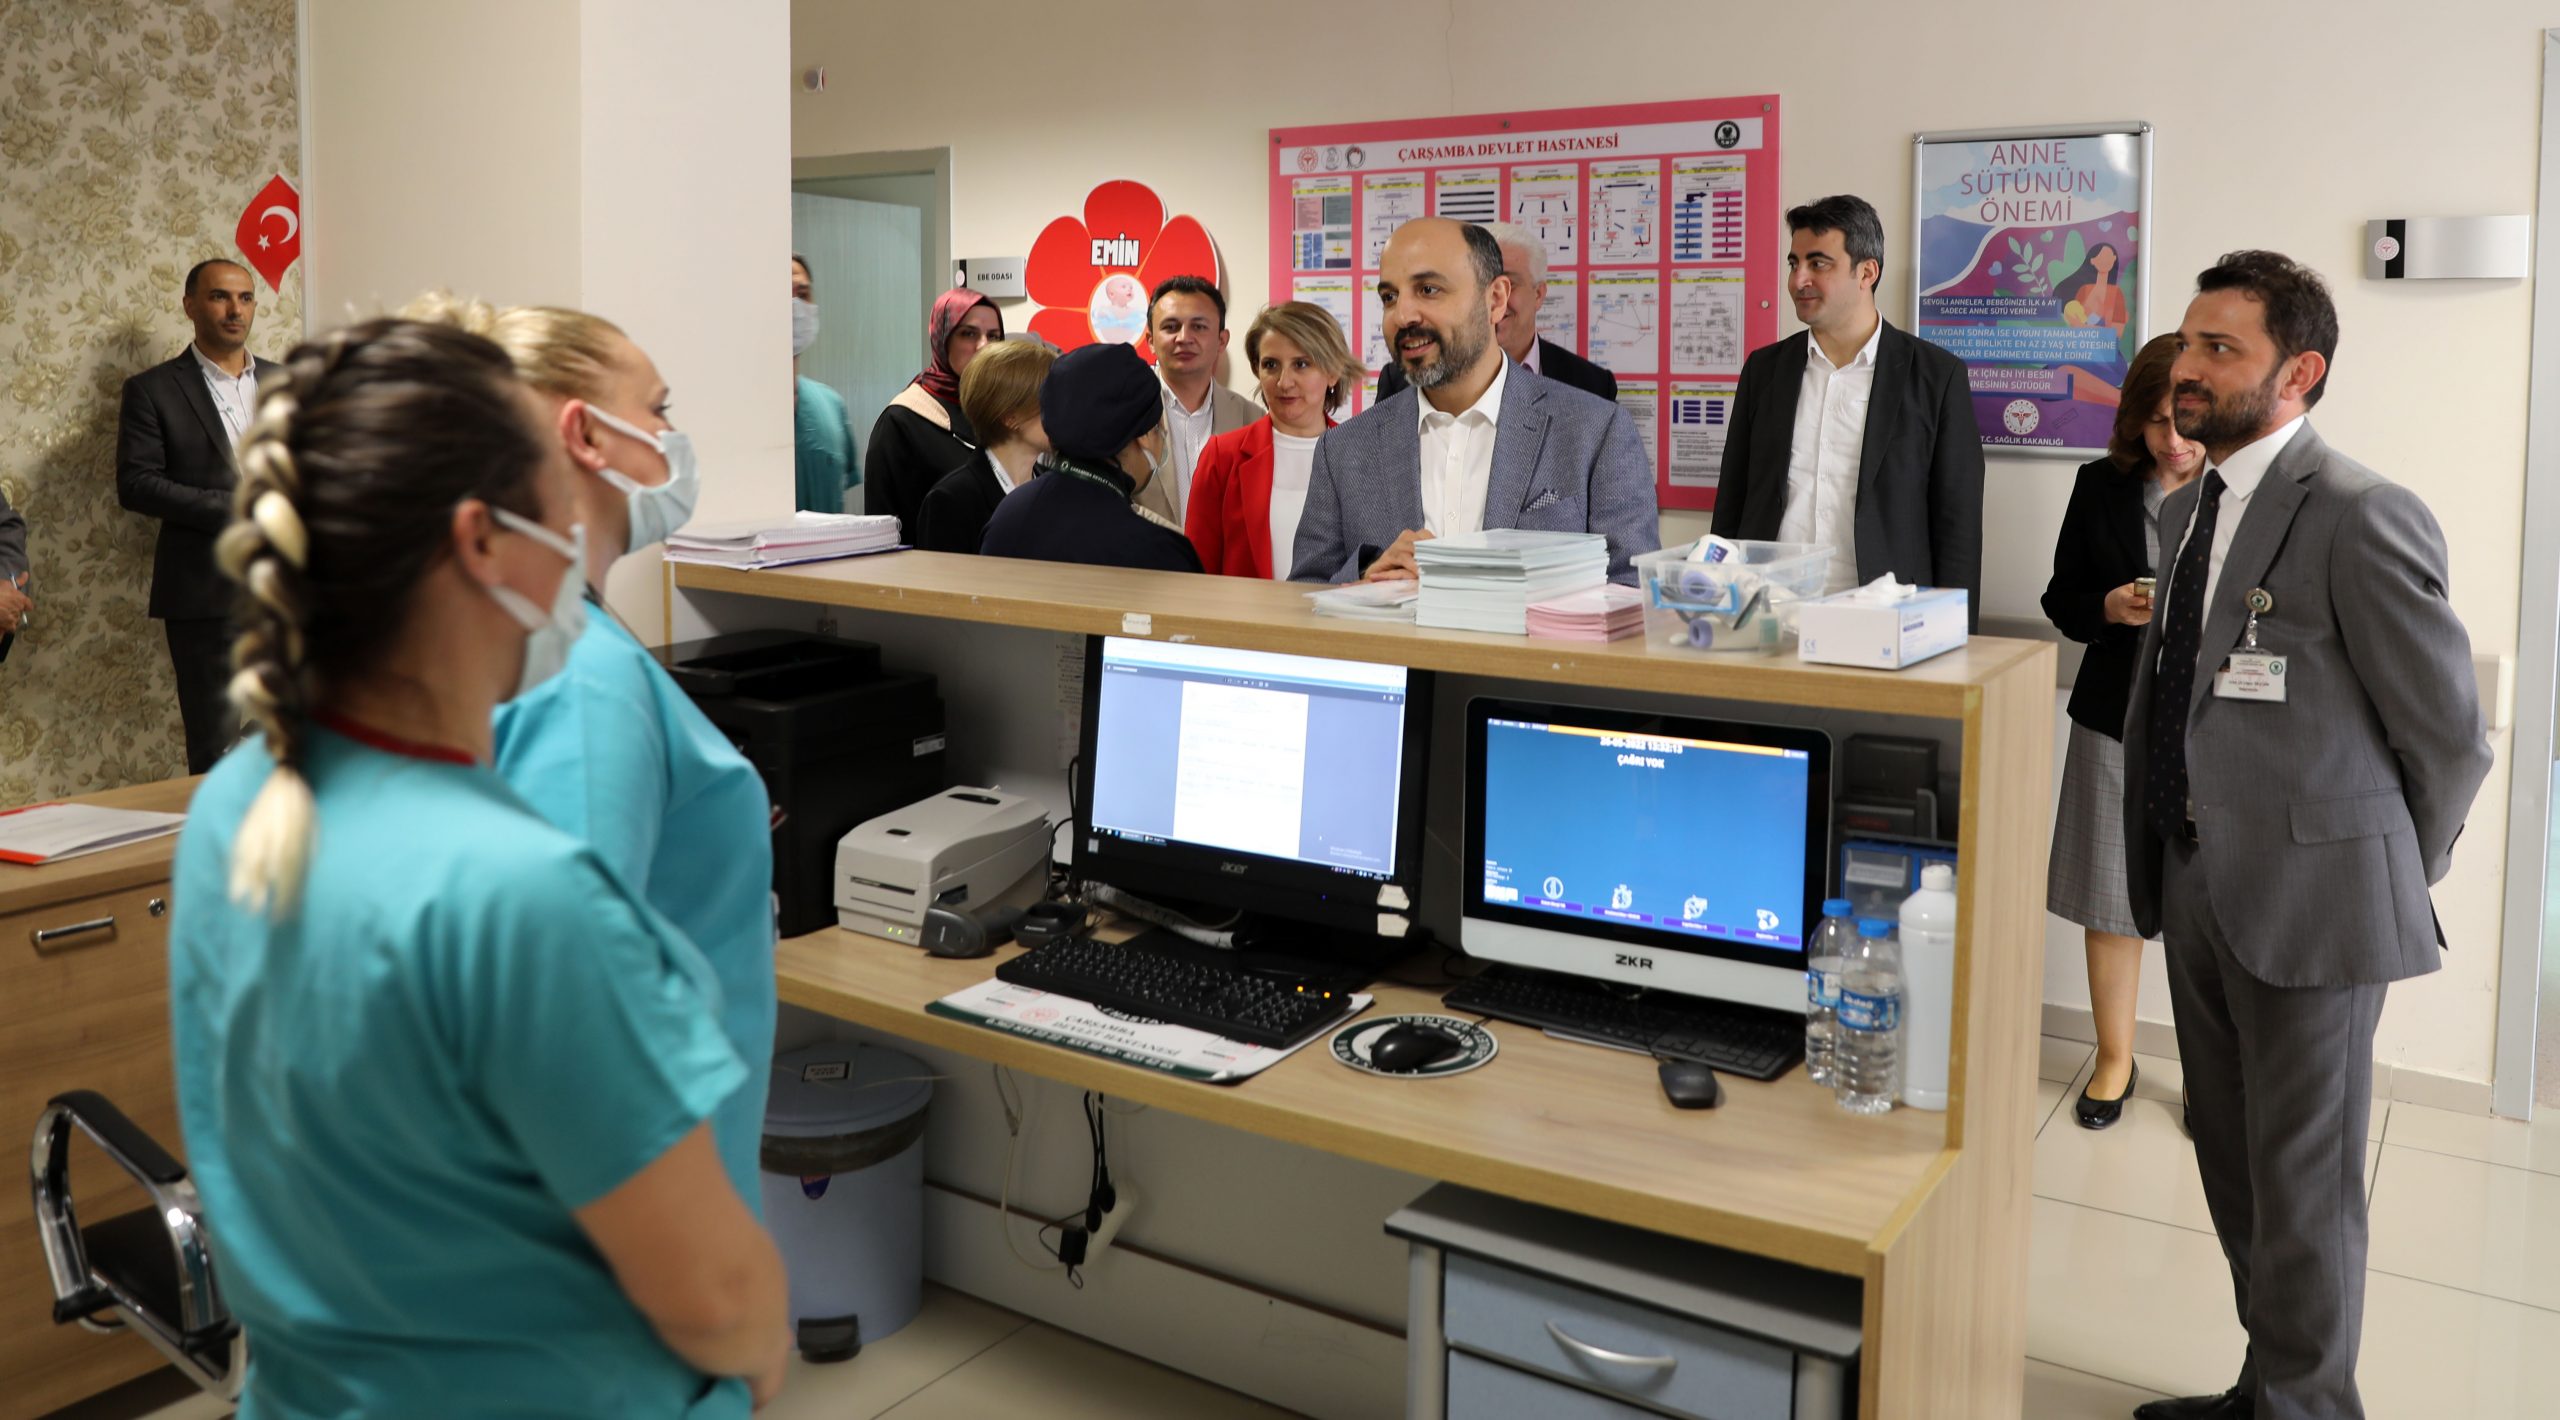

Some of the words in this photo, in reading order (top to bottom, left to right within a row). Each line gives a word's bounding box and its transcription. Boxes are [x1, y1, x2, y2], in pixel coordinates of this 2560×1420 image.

[1398, 144, 1474, 163] ÇARŞAMBA
[1478, 140, 1534, 156] DEVLET
[1538, 132, 1619, 152] HASTANESİ
[1990, 142, 2066, 165] ANNE
[1961, 167, 2096, 195] SÜTÜNÜN
[1980, 196, 2071, 222] ÖNEMİ
[1090, 231, 1140, 267] EMİN
[977, 273, 990, 281] EBE
[991, 272, 1013, 280] ODASI
[1922, 298, 1949, 306] SEVGİLİ
[1950, 299, 1984, 307] ANNELER,
[1990, 306, 2008, 315] SÜTÜ
[2009, 307, 2038, 315] VERİNİZ
[1938, 328, 1965, 336] AYDAN
[1967, 328, 1995, 337] SONRA
[2013, 329, 2041, 338] UYGUN
[2043, 330, 2099, 338] TAMAMLAYICI
[1975, 338, 2013, 348] BİRLİKTE
[2015, 340, 2026, 348] EN
[2028, 340, 2039, 348] AZ
[2041, 340, 2046, 348] 2
[2048, 340, 2064, 350] YAŞ
[2066, 341, 2078, 349] VE
[1983, 350, 2031, 358] EMZİRMEYE
[2033, 351, 2062, 359] DEVAM
[1968, 369, 1979, 378] EK
[1981, 369, 1998, 380] İÇİN
[2001, 370, 2012, 379] EN
[2015, 369, 2025, 378] İYİ
[2027, 370, 2054, 379] BESİN
[1980, 436, 1994, 444] T.C.
[1994, 435, 2021, 444] SAĞLIK
[2022, 437, 2064, 446] BAKANLIĞI
[1646, 756, 1665, 769] YOK
[1220, 861, 1249, 874] acer
[1615, 952, 1654, 970] ZKR
